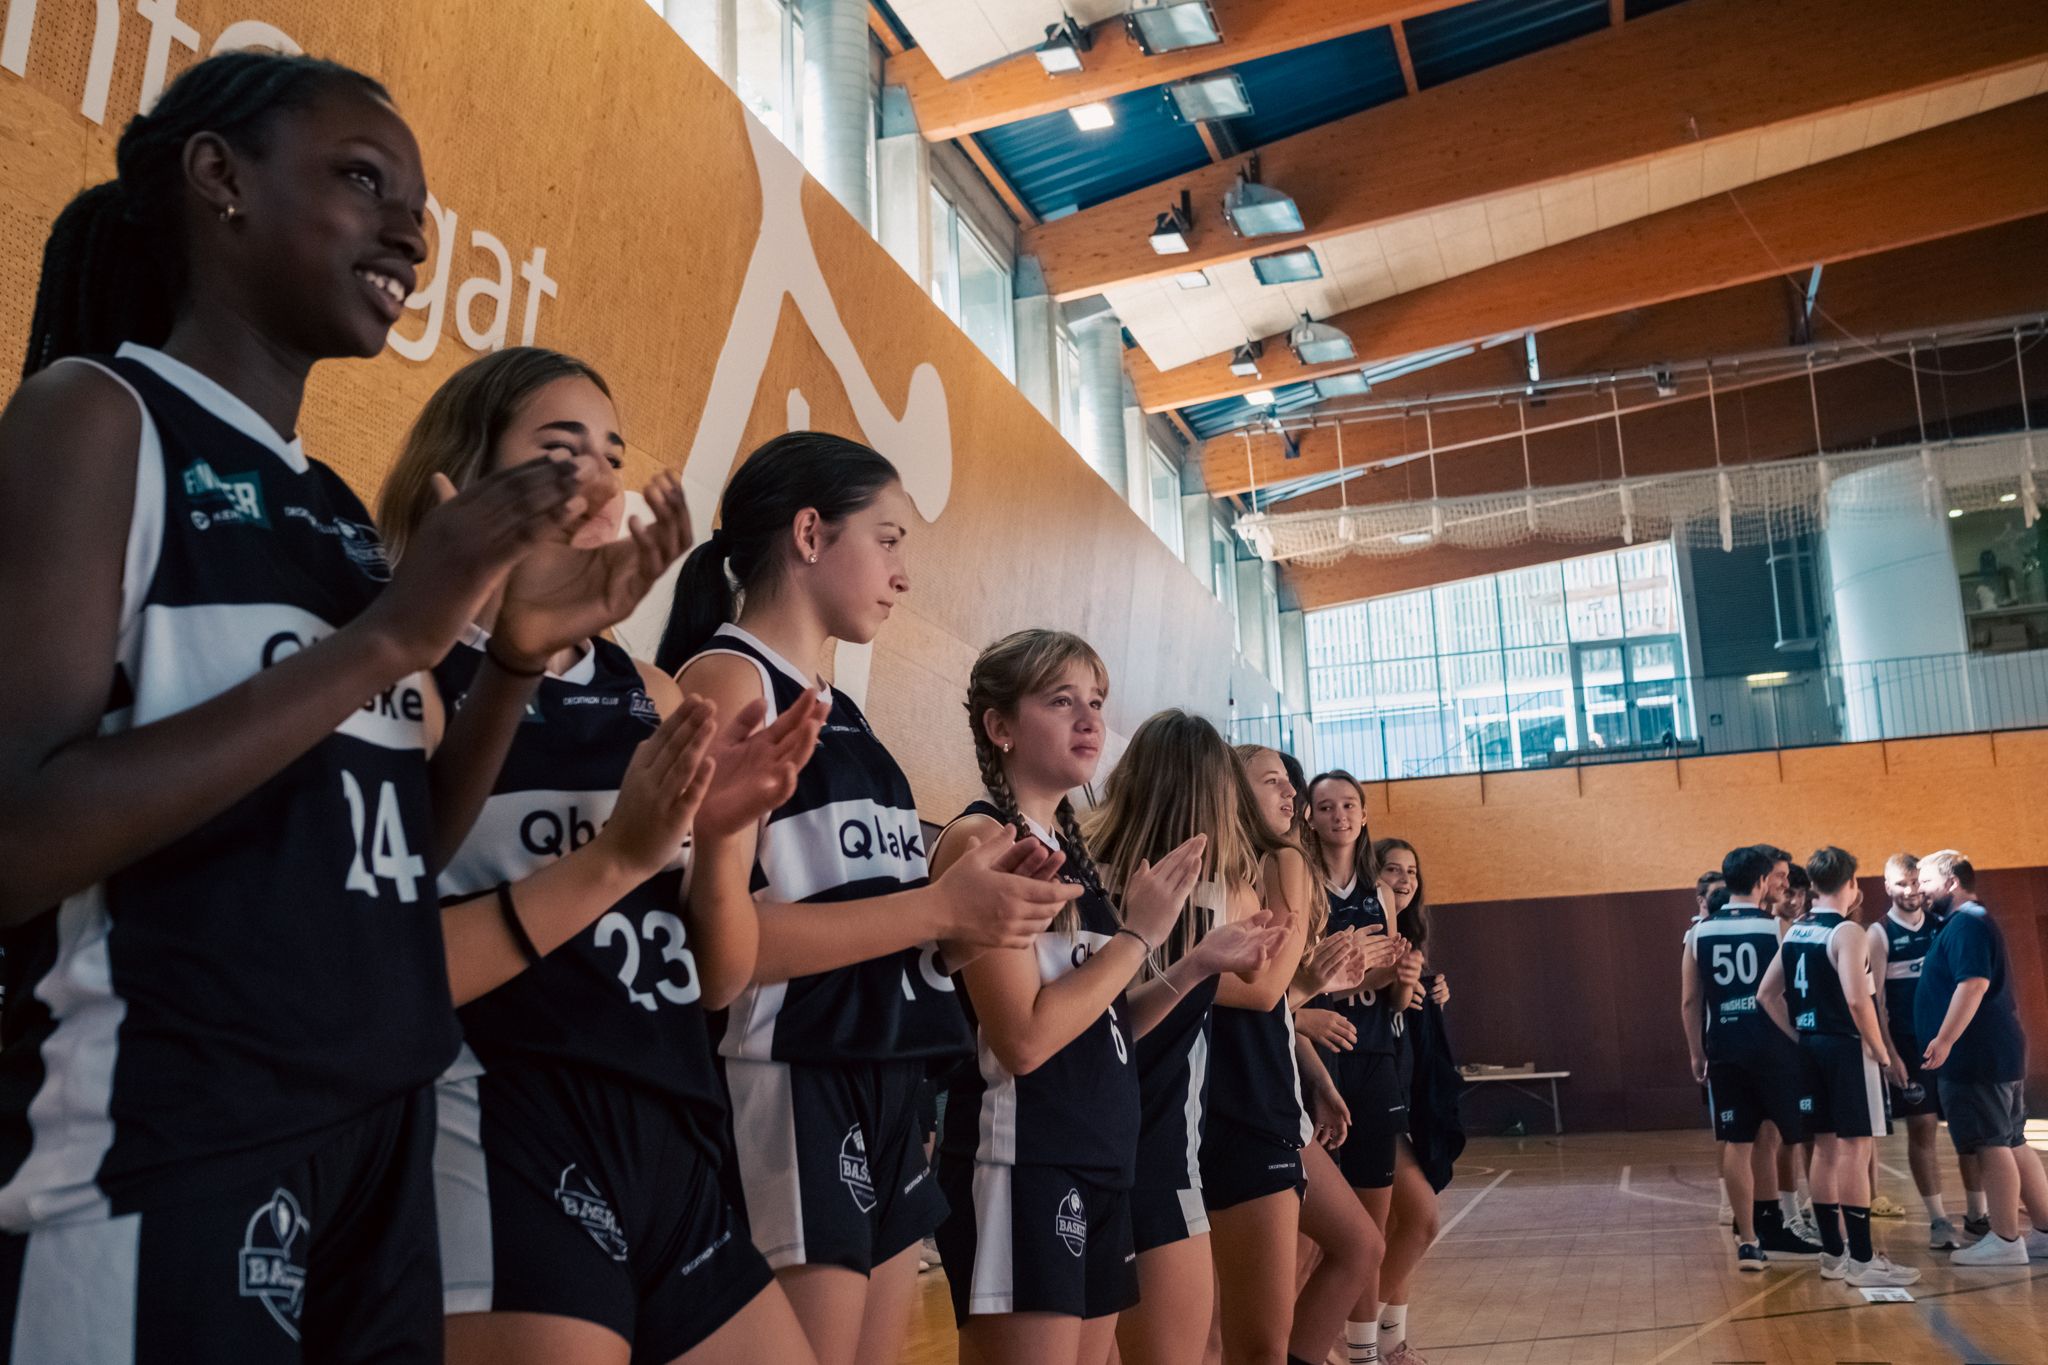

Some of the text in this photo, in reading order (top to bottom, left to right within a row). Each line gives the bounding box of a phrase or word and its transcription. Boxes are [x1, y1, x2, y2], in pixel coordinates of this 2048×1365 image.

[594, 910, 701, 1011] 23
[1712, 942, 1758, 985] 50
[1794, 952, 1808, 998] 4
